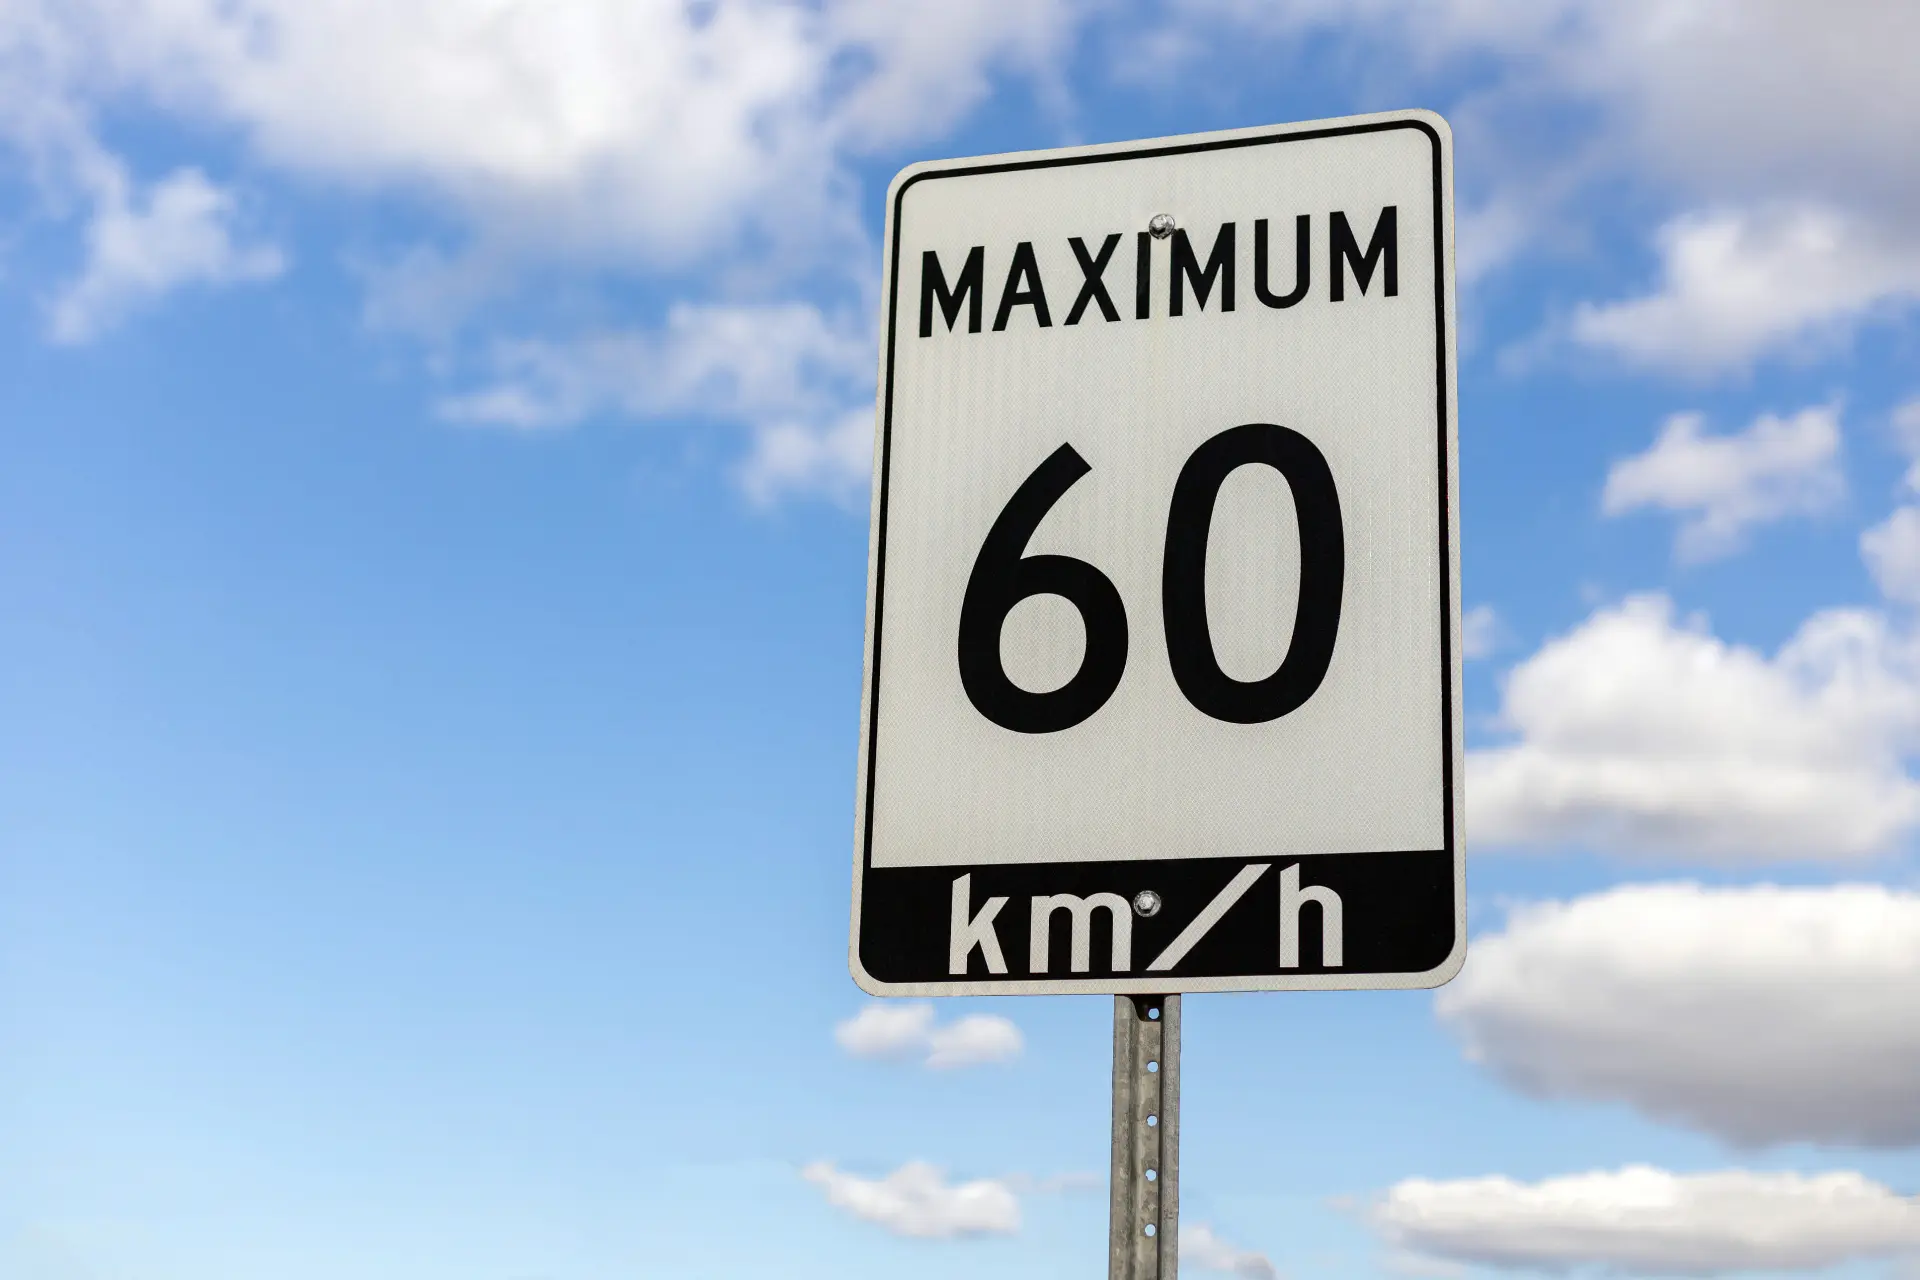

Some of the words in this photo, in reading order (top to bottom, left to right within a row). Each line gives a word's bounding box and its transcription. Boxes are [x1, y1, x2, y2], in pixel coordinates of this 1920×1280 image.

[919, 206, 1398, 338] MAXIMUM
[958, 423, 1344, 735] 60
[949, 863, 1343, 975] km/h
